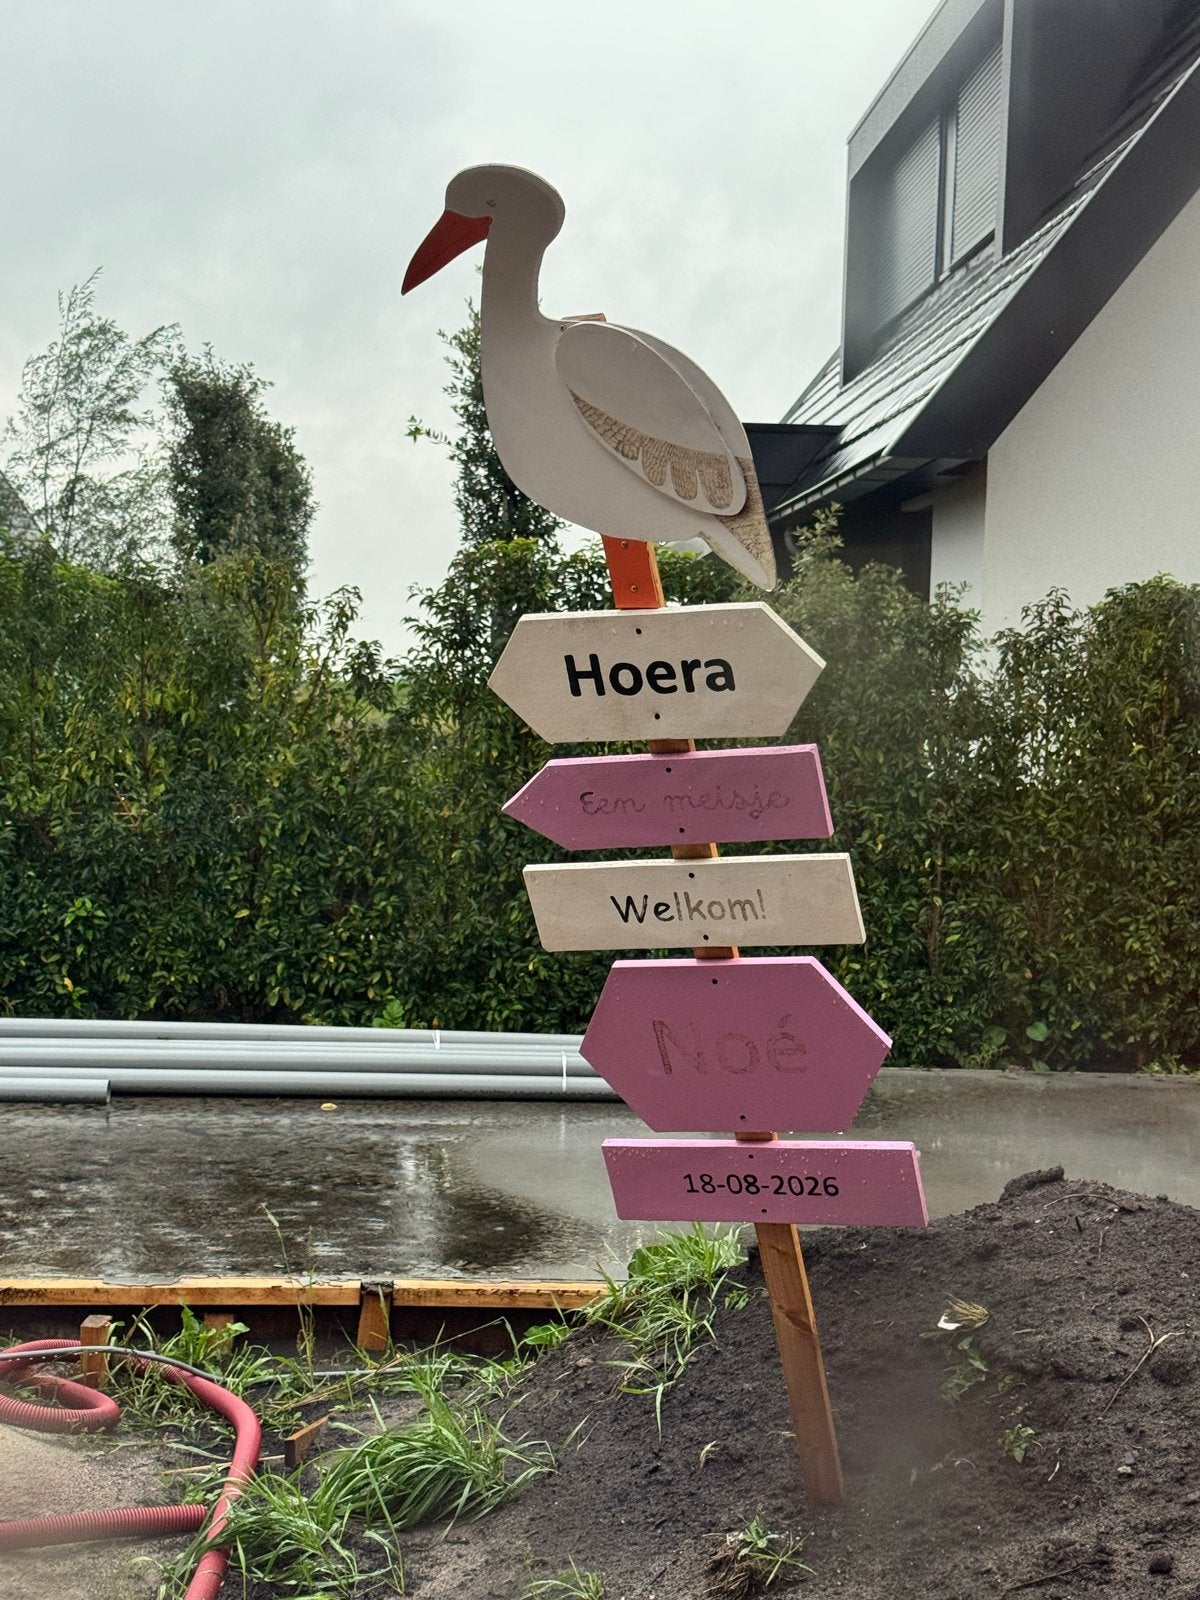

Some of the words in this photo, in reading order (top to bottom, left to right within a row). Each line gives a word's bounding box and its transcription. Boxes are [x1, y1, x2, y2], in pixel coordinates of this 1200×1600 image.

[564, 653, 736, 696] Hoera
[579, 791, 646, 816] Een
[663, 784, 790, 820] meisje
[610, 889, 768, 924] Welkom!
[652, 1014, 808, 1075] Noé
[683, 1173, 840, 1196] 18-08-2026
